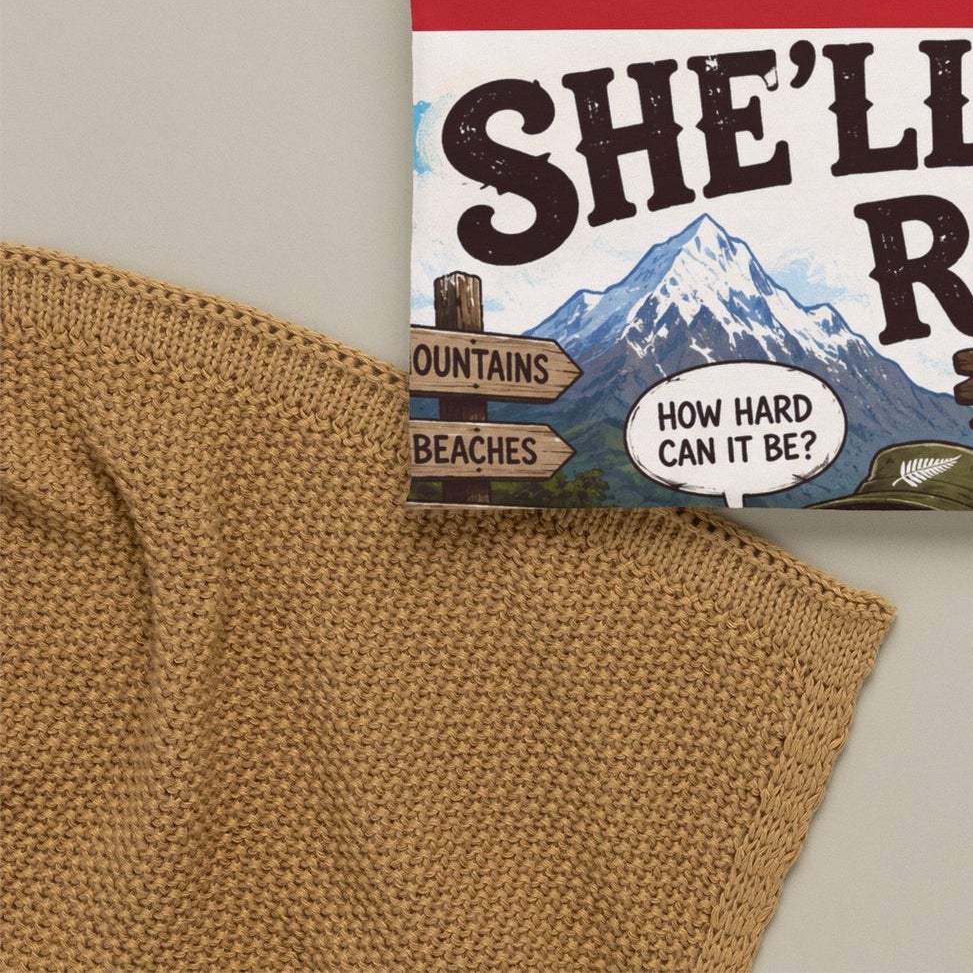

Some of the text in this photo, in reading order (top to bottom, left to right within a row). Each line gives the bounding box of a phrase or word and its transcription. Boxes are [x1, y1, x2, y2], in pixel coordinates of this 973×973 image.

[409, 343, 549, 384] OUNTAINS
[657, 394, 813, 431] HOW HARD
[413, 433, 538, 465] BEACHES
[658, 430, 817, 467] CAN IT BE?
